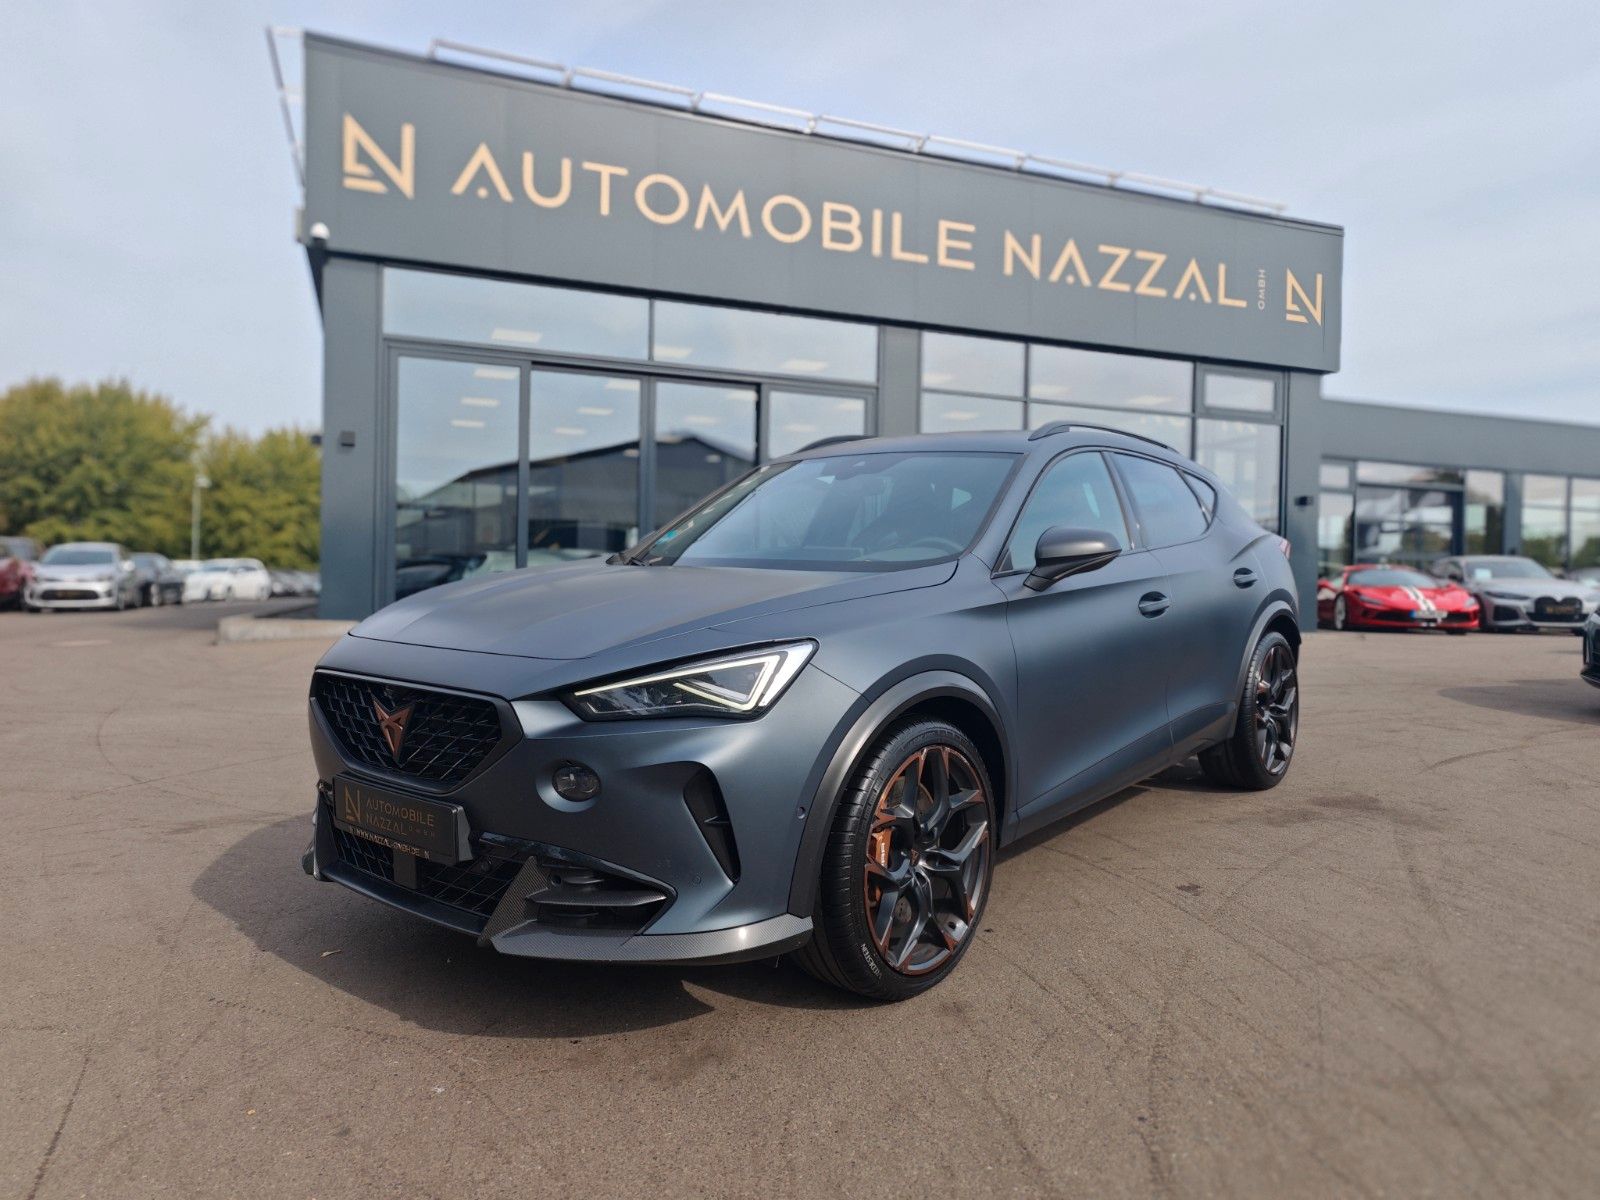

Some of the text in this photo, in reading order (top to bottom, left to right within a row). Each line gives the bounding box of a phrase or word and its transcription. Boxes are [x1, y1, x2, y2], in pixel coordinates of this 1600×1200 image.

[451, 142, 975, 270] AUTOMOBILE
[1003, 230, 1247, 308] NAZZAL
[366, 798, 434, 827] AUTOMOBILE
[366, 814, 407, 836] NAZZAL
